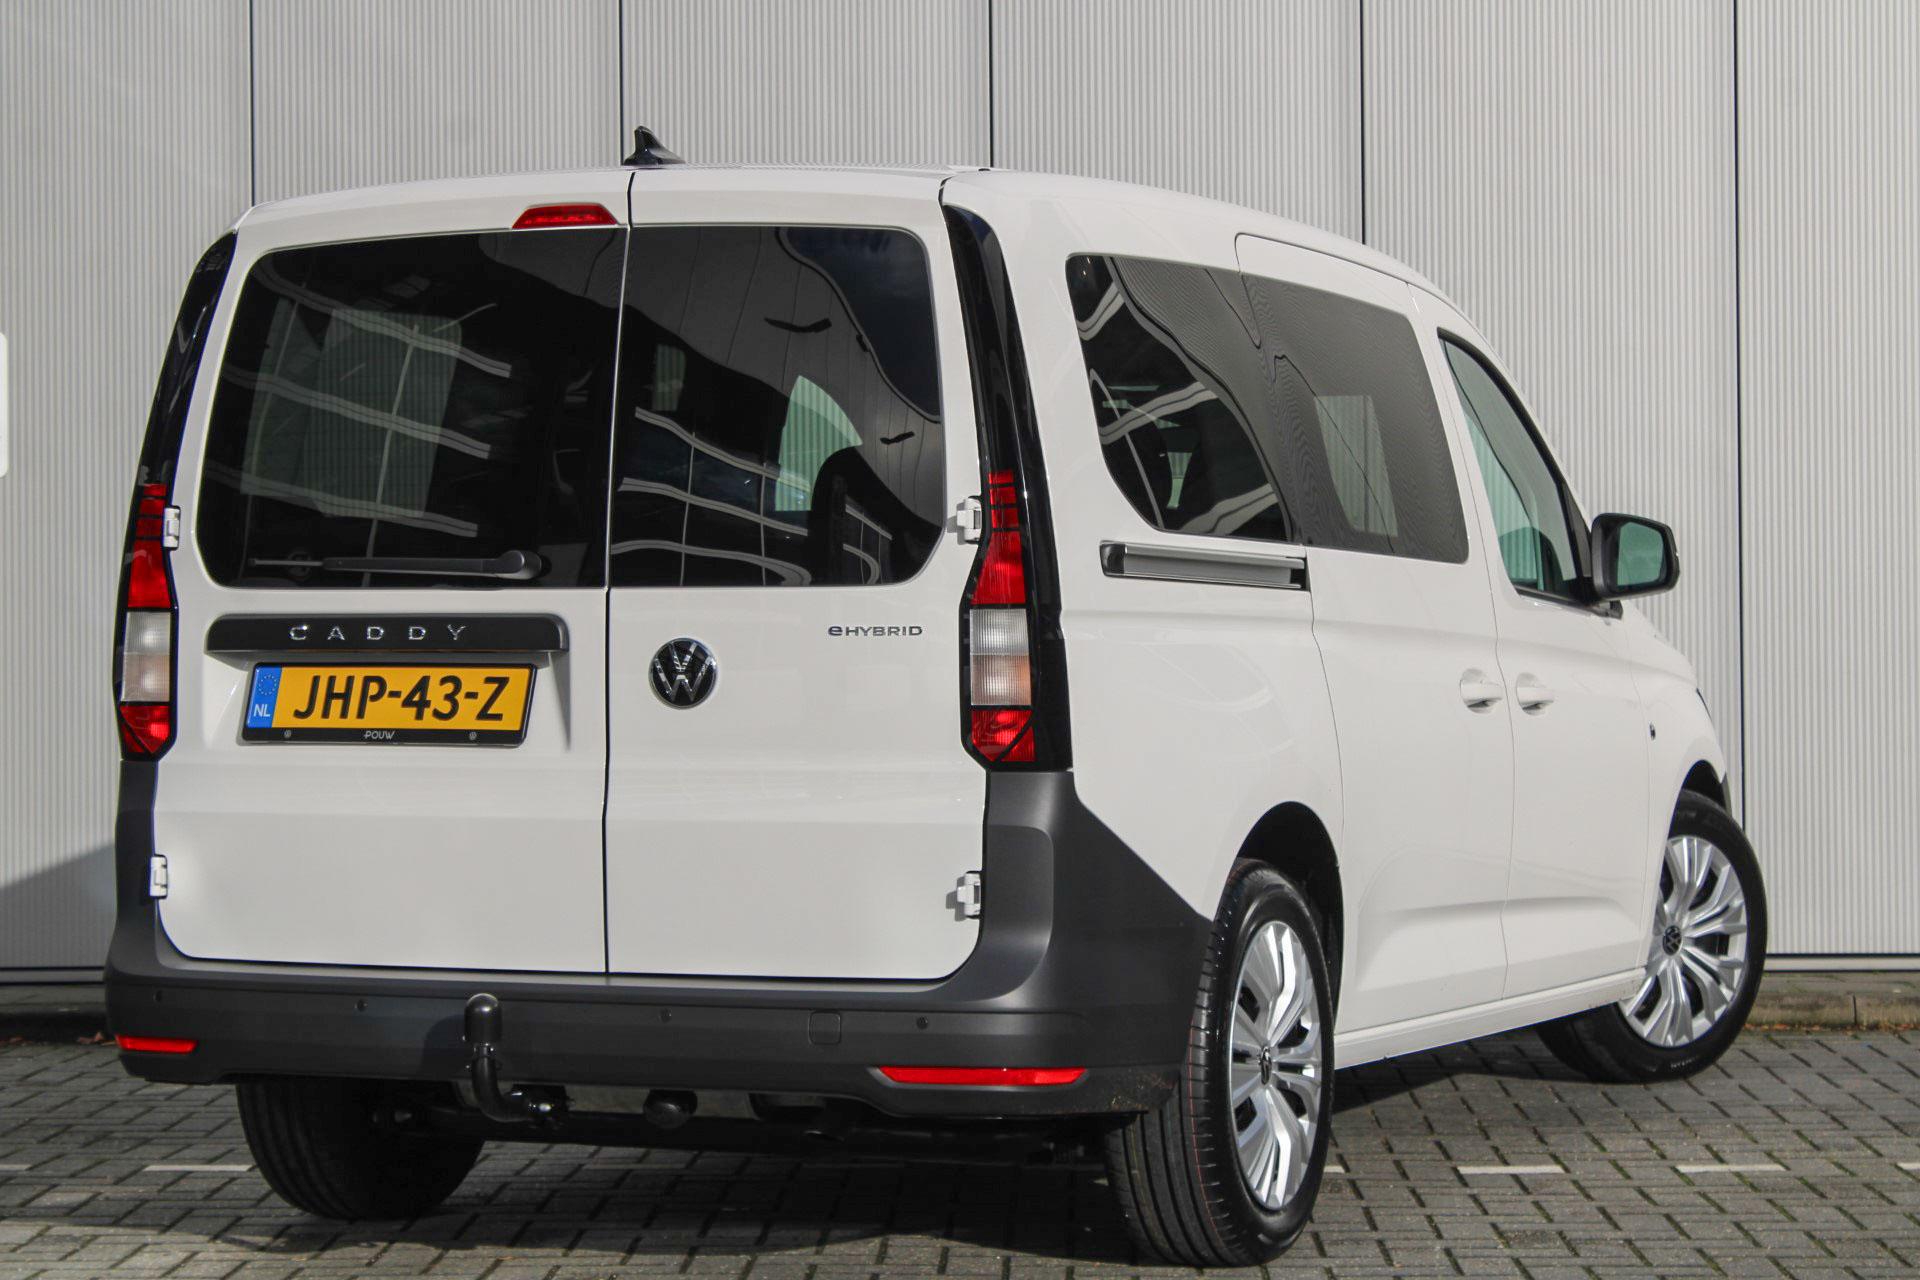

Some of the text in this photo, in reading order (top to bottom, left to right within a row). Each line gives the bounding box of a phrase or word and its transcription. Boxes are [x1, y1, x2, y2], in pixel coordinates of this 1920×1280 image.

[289, 625, 467, 641] CADDY
[827, 625, 923, 637] eHYBRID
[651, 639, 716, 704] VW
[293, 674, 510, 721] JHP-43-Z
[253, 703, 271, 718] NL
[364, 730, 395, 740] POUW
